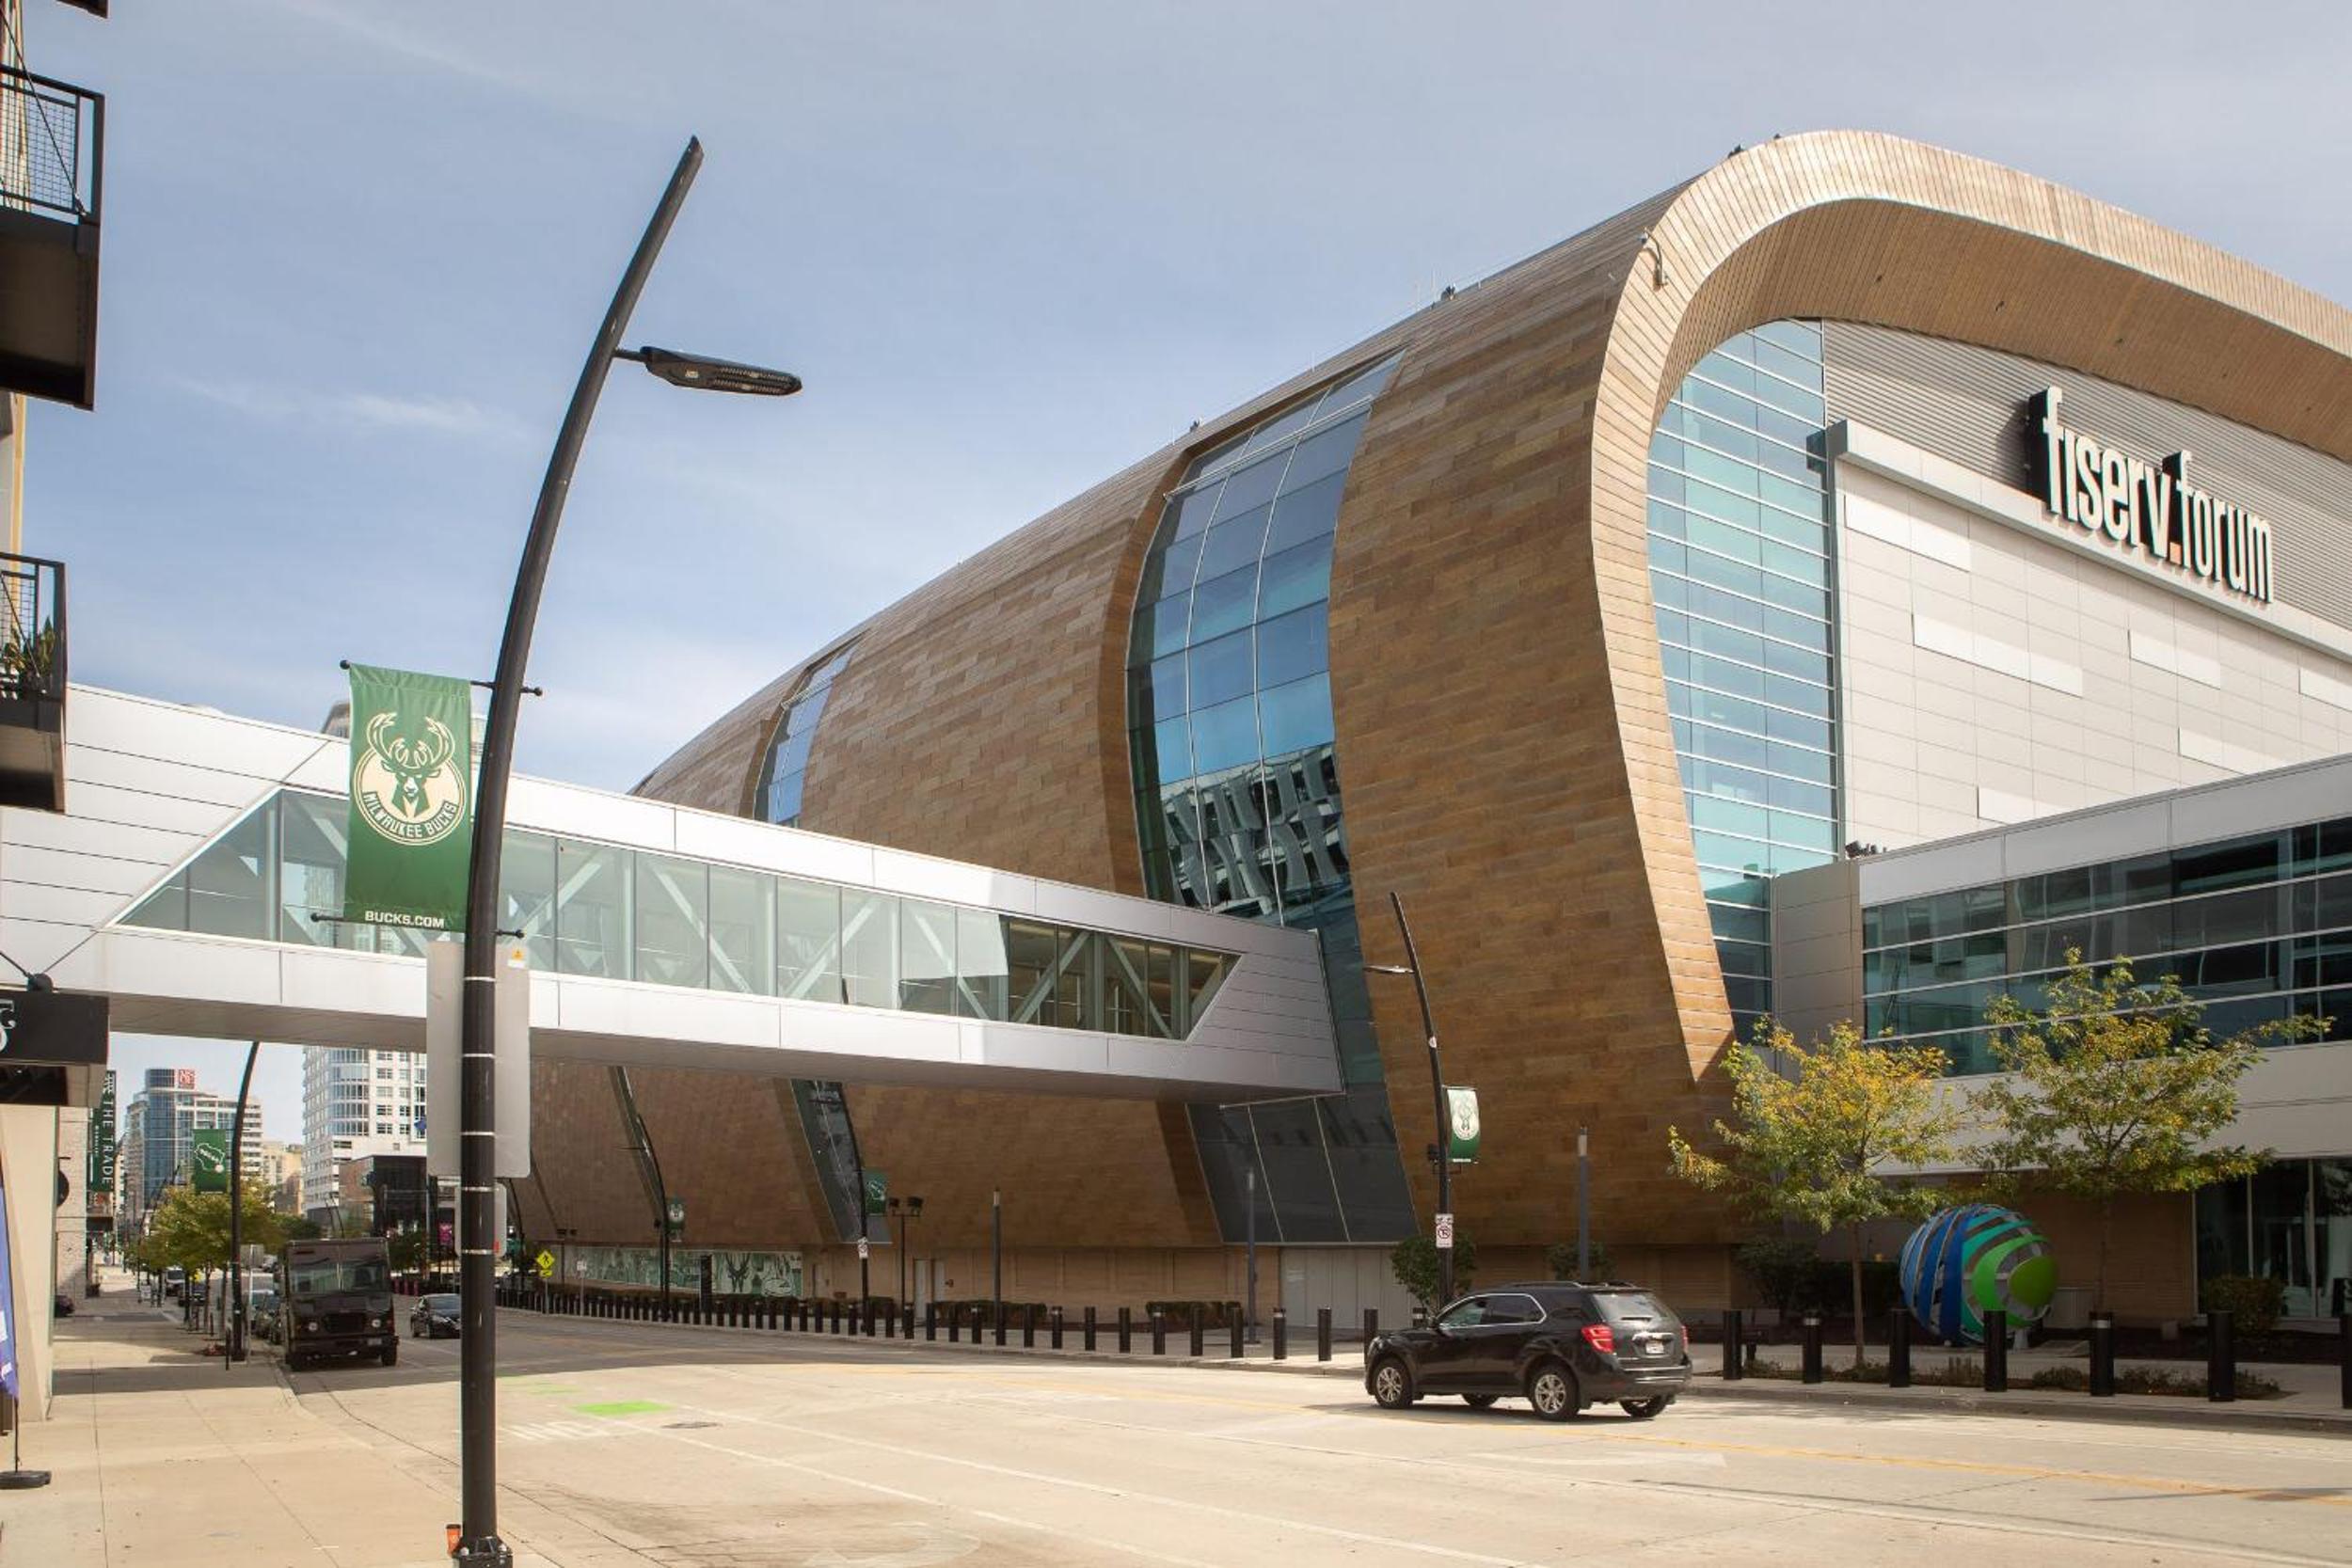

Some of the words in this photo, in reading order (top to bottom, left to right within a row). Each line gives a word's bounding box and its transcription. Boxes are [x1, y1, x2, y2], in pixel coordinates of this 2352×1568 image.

[362, 793, 422, 838] MILWAUKEE
[425, 801, 457, 835] BUCKS
[364, 911, 445, 929] BUCKS.COM
[103, 1100, 115, 1129] THE
[103, 1136, 115, 1186] TRADE
